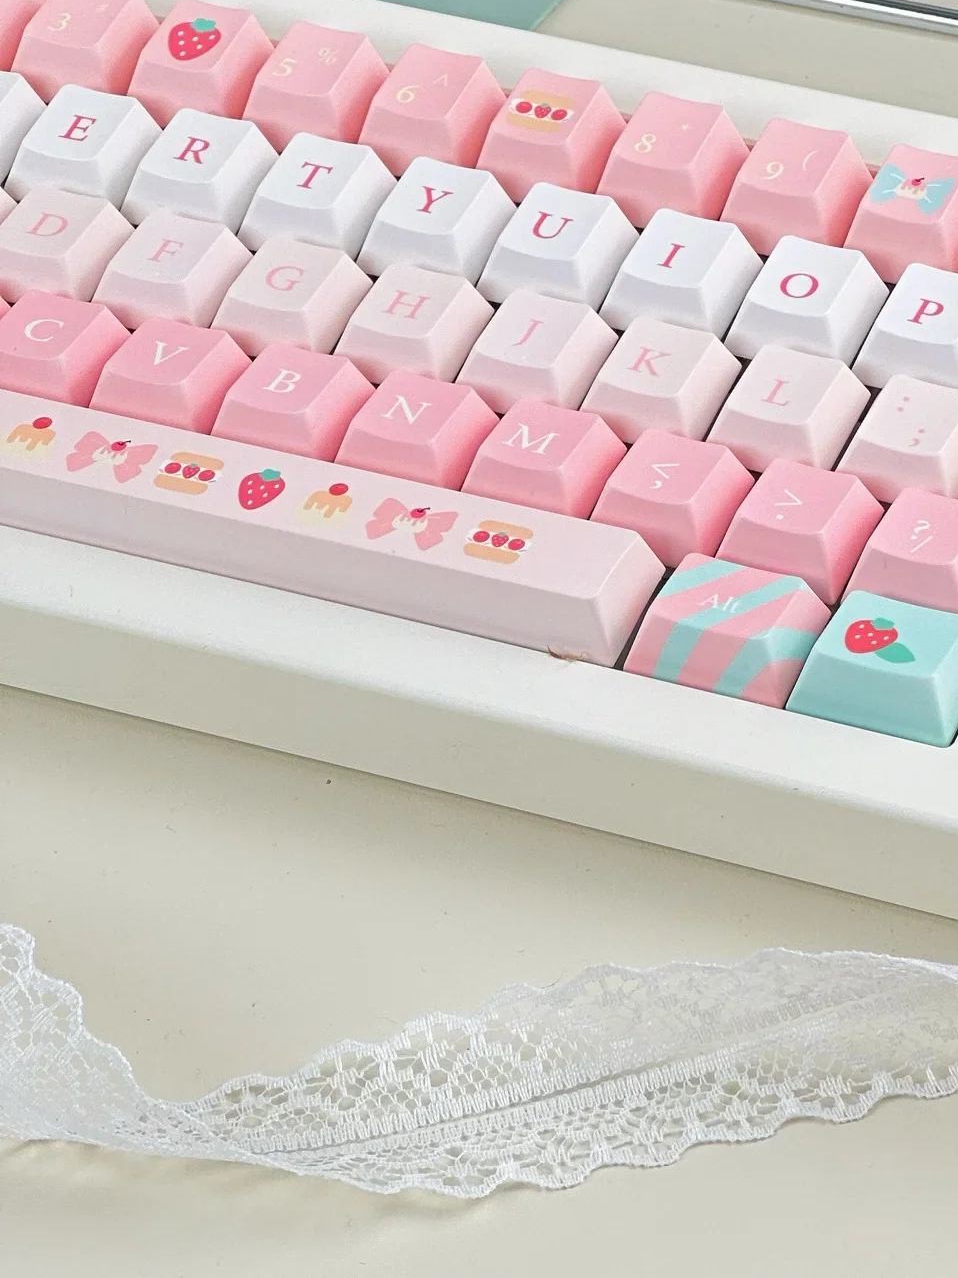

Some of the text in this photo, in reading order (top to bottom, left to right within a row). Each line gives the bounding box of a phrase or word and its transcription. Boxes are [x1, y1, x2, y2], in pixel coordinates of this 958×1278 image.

[46, 12, 71, 32] 3
[272, 57, 298, 77] 5
[318, 47, 340, 65] %
[395, 84, 421, 104] 6
[58, 114, 96, 143] E
[173, 136, 211, 165] R
[634, 133, 657, 154] 8
[296, 162, 334, 190] T
[760, 160, 785, 181] 9
[416, 186, 454, 215] Y
[24, 211, 69, 237] D
[532, 211, 574, 240] U
[148, 239, 184, 263] F
[656, 243, 686, 269] I
[265, 265, 304, 292] G
[779, 273, 820, 299] O
[382, 289, 431, 320] H
[907, 298, 944, 325] P
[23, 319, 65, 343] C
[512, 318, 544, 347] J
[150, 340, 189, 366] V
[626, 346, 672, 378] K
[264, 368, 301, 394] B
[761, 378, 792, 408] L
[381, 394, 433, 425] N
[501, 422, 560, 456] M
[697, 593, 741, 614] Alt
